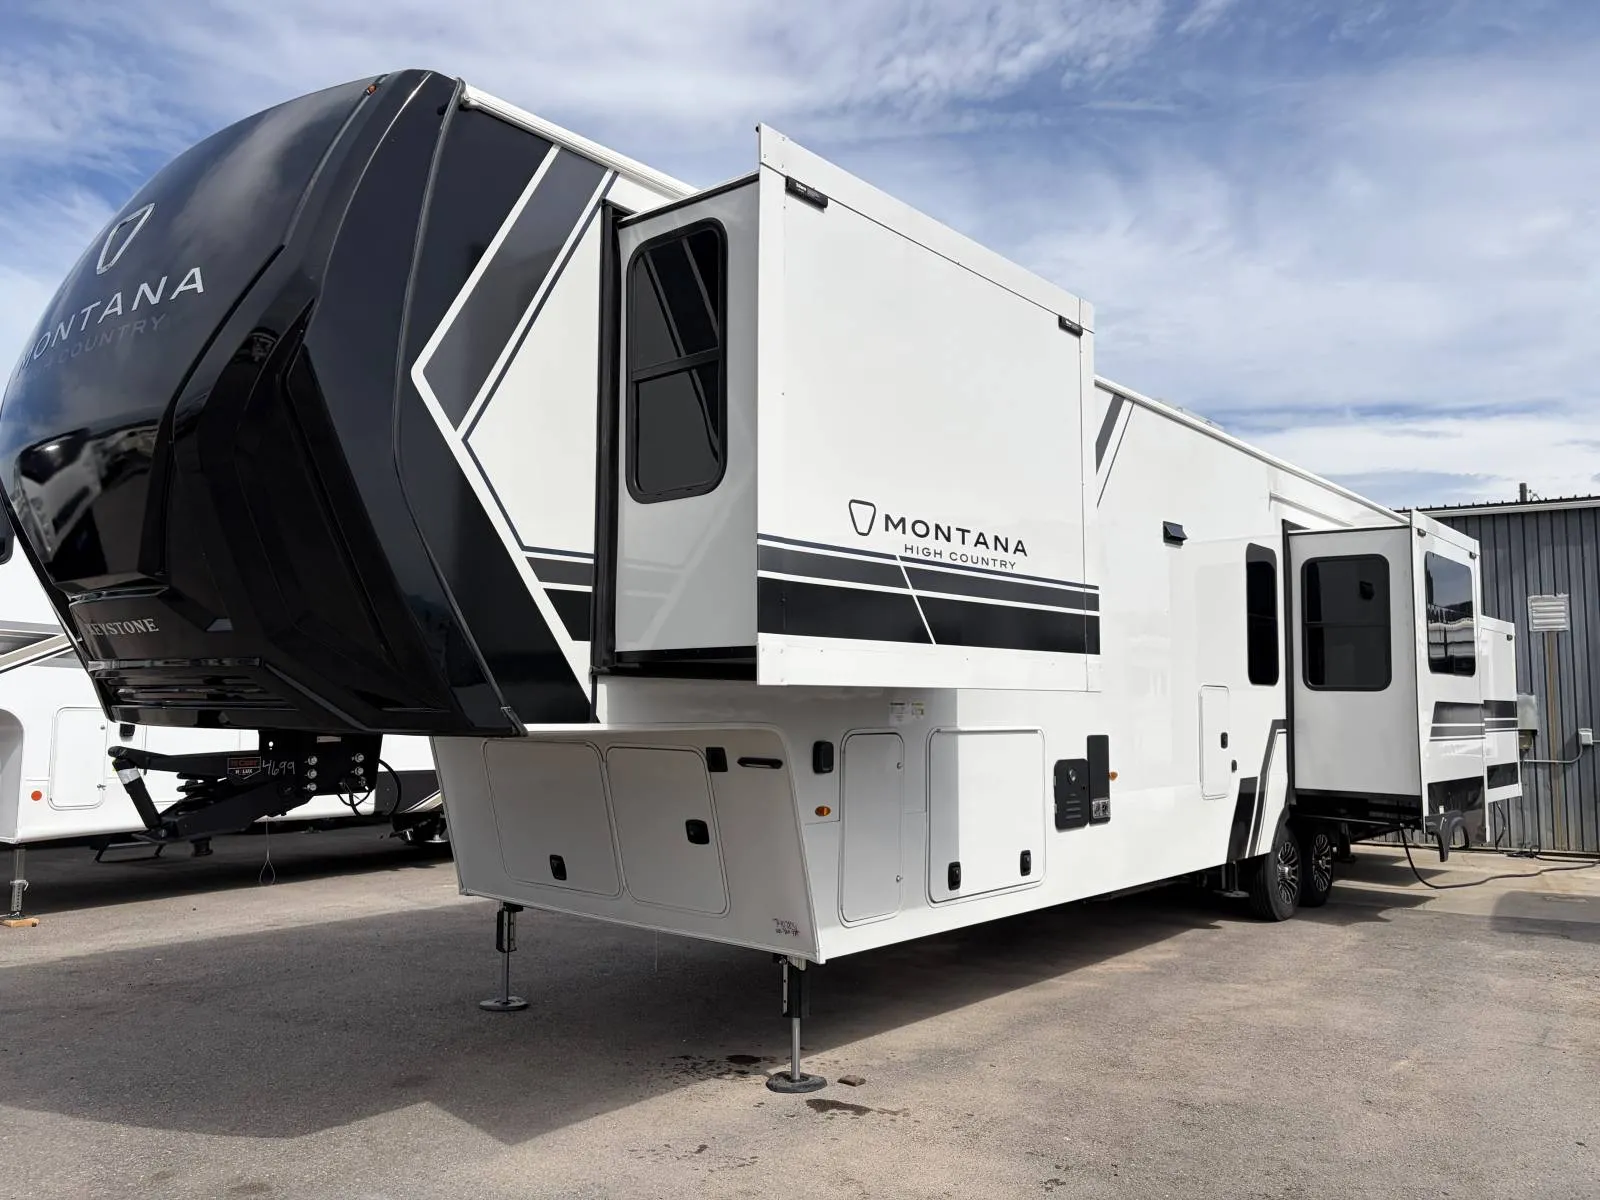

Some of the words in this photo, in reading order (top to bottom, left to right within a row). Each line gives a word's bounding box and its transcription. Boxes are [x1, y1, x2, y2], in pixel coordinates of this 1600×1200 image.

[57, 314, 166, 363] COUNTRY
[884, 513, 1028, 557] MONTANA
[904, 543, 943, 559] HIGH
[949, 551, 1016, 570] COUNTRY
[262, 759, 296, 776] 4699
